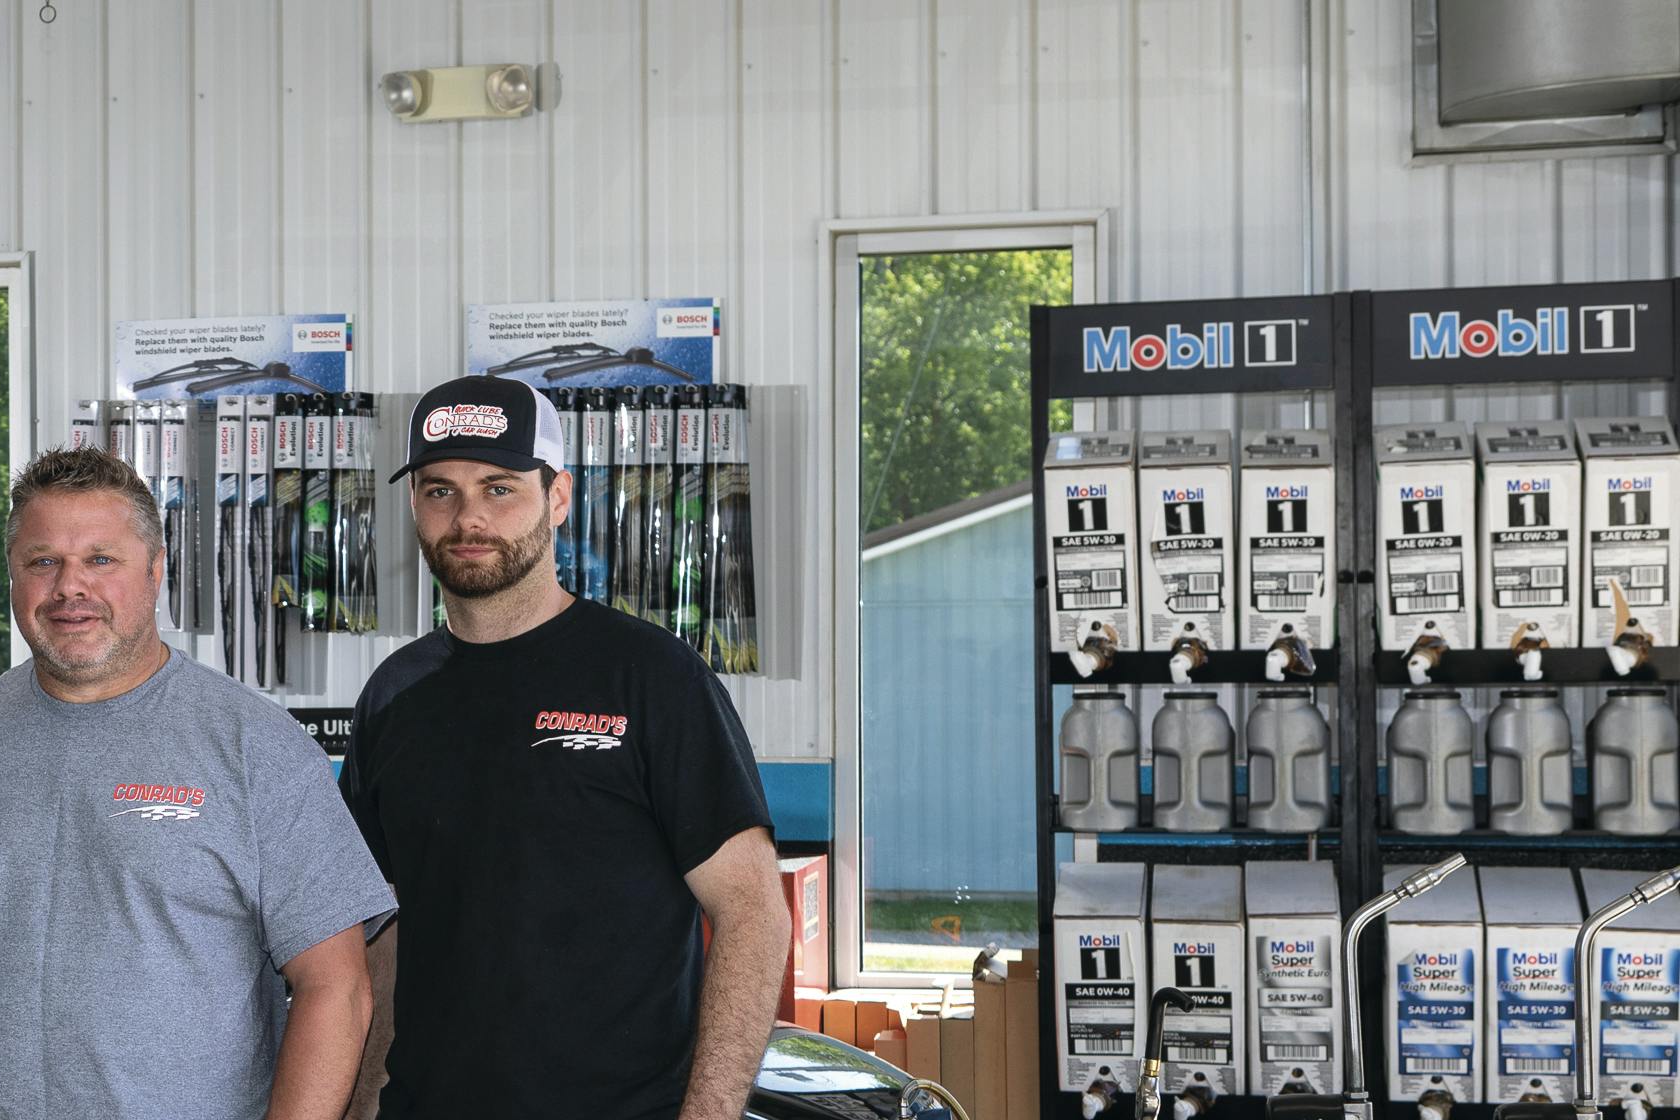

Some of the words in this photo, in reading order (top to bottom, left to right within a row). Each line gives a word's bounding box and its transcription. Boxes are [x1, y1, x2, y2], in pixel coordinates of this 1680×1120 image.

[489, 312, 523, 320] Checked
[526, 312, 544, 320] your
[547, 310, 569, 319] wiper
[572, 309, 599, 318] blades
[602, 308, 628, 318] lately?
[677, 315, 707, 323] BOSCH
[135, 328, 167, 336] Checked
[170, 328, 187, 337] your
[188, 326, 210, 335] wiper
[212, 325, 238, 333] blades
[240, 323, 266, 333] lately?
[489, 322, 522, 331] Replace
[525, 321, 546, 329] them
[548, 320, 566, 328] with
[569, 319, 598, 329] quality
[600, 318, 627, 327] Bosch
[311, 330, 341, 338] BOSCH
[488, 331, 534, 340] windshield
[537, 331, 560, 339] wiper
[1409, 306, 1569, 360] Mobil
[135, 338, 166, 347] Replace
[168, 337, 188, 345] them
[191, 336, 208, 344] with
[211, 335, 237, 344] quality
[239, 334, 264, 342] Bosch
[135, 347, 177, 355] windshield
[179, 346, 201, 355] wiper
[1082, 322, 1234, 373] Mobil
[478, 406, 502, 415] LUBE
[426, 408, 507, 437] CONRAD'S
[279, 421, 287, 449] BOSCH
[476, 427, 498, 436] WASH
[1506, 478, 1551, 492] Mobil
[1607, 477, 1652, 490] Mobil
[1066, 484, 1107, 497] Mobil
[1162, 488, 1204, 501] Mobil
[1266, 485, 1308, 498] Mobil
[1400, 486, 1443, 499] Mobil
[1062, 537, 1082, 546] SAE
[1084, 535, 1116, 545] 5W-30
[1259, 538, 1280, 547] SAE
[1281, 537, 1316, 547] 5W-30
[1500, 532, 1521, 542] SAE
[1523, 531, 1559, 541] 0W-20
[1599, 531, 1621, 541] SAE
[1623, 530, 1660, 540] 0W-20
[1159, 541, 1179, 551] SAE
[1181, 539, 1214, 549] 5W-30
[1395, 540, 1416, 549] SAE
[1418, 538, 1453, 548] 0W-20
[535, 710, 628, 736] CONRAD'S
[112, 782, 206, 807] CONRAD'S
[1079, 934, 1120, 947] Mobil
[1271, 941, 1315, 953] Mobil
[1173, 942, 1215, 954] Mobil
[1271, 954, 1314, 967] Super
[1415, 953, 1457, 966] Mobil
[1512, 953, 1557, 965] Mobil
[1617, 953, 1663, 966] Mobil
[1261, 968, 1305, 979] Synthetic
[1307, 968, 1330, 977] Euro
[1413, 966, 1457, 979] Super
[1513, 966, 1557, 979] Super
[1617, 966, 1662, 979] Super
[1075, 988, 1096, 996] SAE
[1097, 987, 1130, 996] 0W-40
[1401, 982, 1426, 993] High
[1429, 982, 1474, 994] Mileage
[1501, 981, 1526, 993] High
[1529, 982, 1575, 994] Mileage
[1603, 981, 1630, 993] High
[1633, 982, 1679, 995] Mileage
[1267, 994, 1288, 1002] SAE
[1290, 994, 1324, 1002] 5W-40
[1408, 1006, 1428, 1015] SAE
[1431, 1006, 1466, 1015] 5W-30
[1507, 1006, 1529, 1014] SAE
[1531, 1006, 1567, 1014] 5W-30
[1610, 1005, 1632, 1015] SAE
[1634, 1006, 1670, 1015] 5W-20
